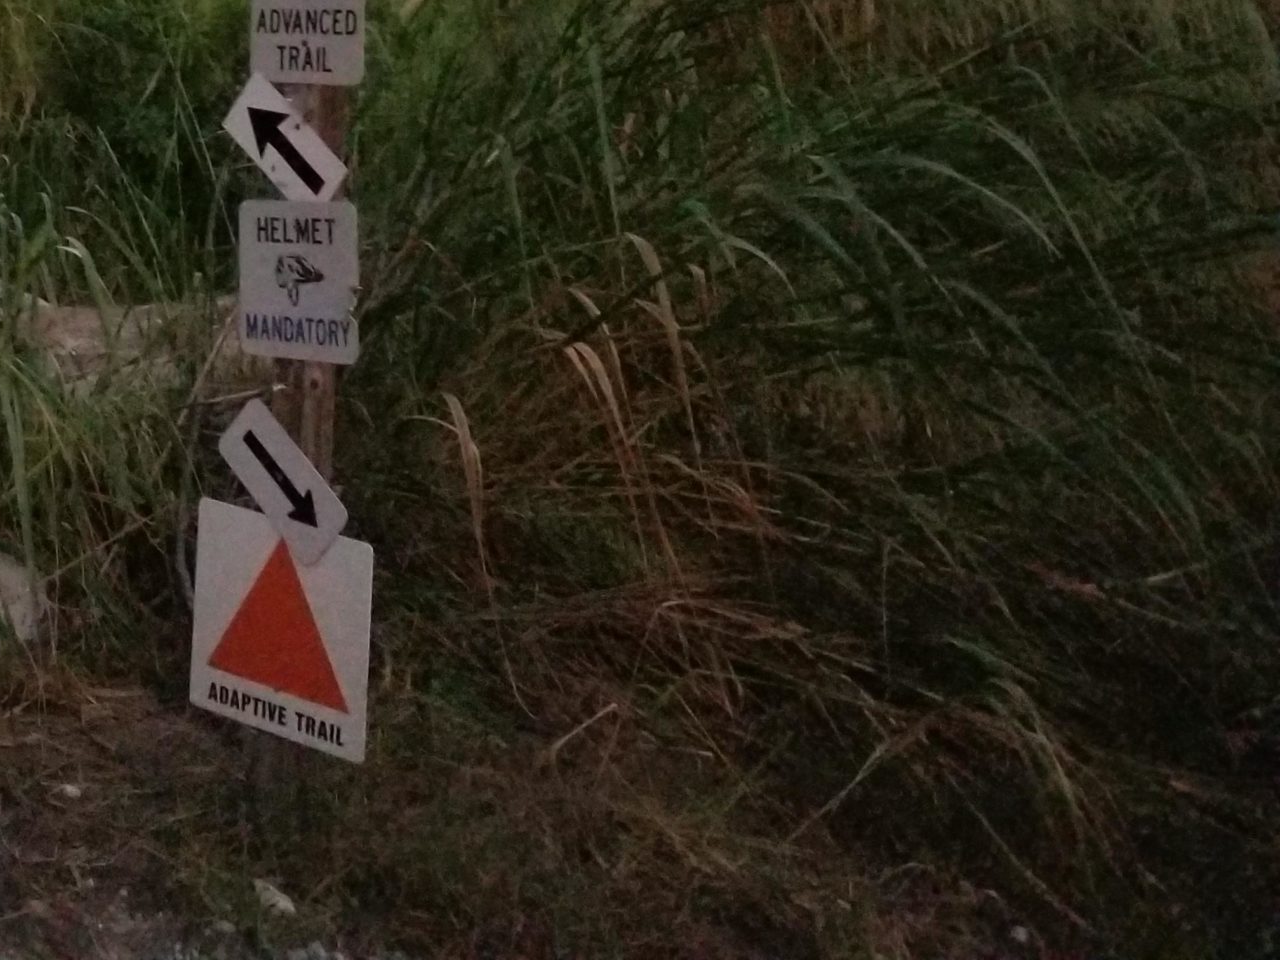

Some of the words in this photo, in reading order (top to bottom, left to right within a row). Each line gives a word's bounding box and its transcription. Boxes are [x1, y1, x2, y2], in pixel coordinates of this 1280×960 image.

[257, 8, 357, 35] ADVANCED
[277, 45, 333, 73] TRAIL
[257, 217, 335, 245] HELMET
[246, 313, 351, 347] MANDATORY
[208, 682, 288, 726] ADAPTIVE
[295, 711, 344, 747] TRAIL
